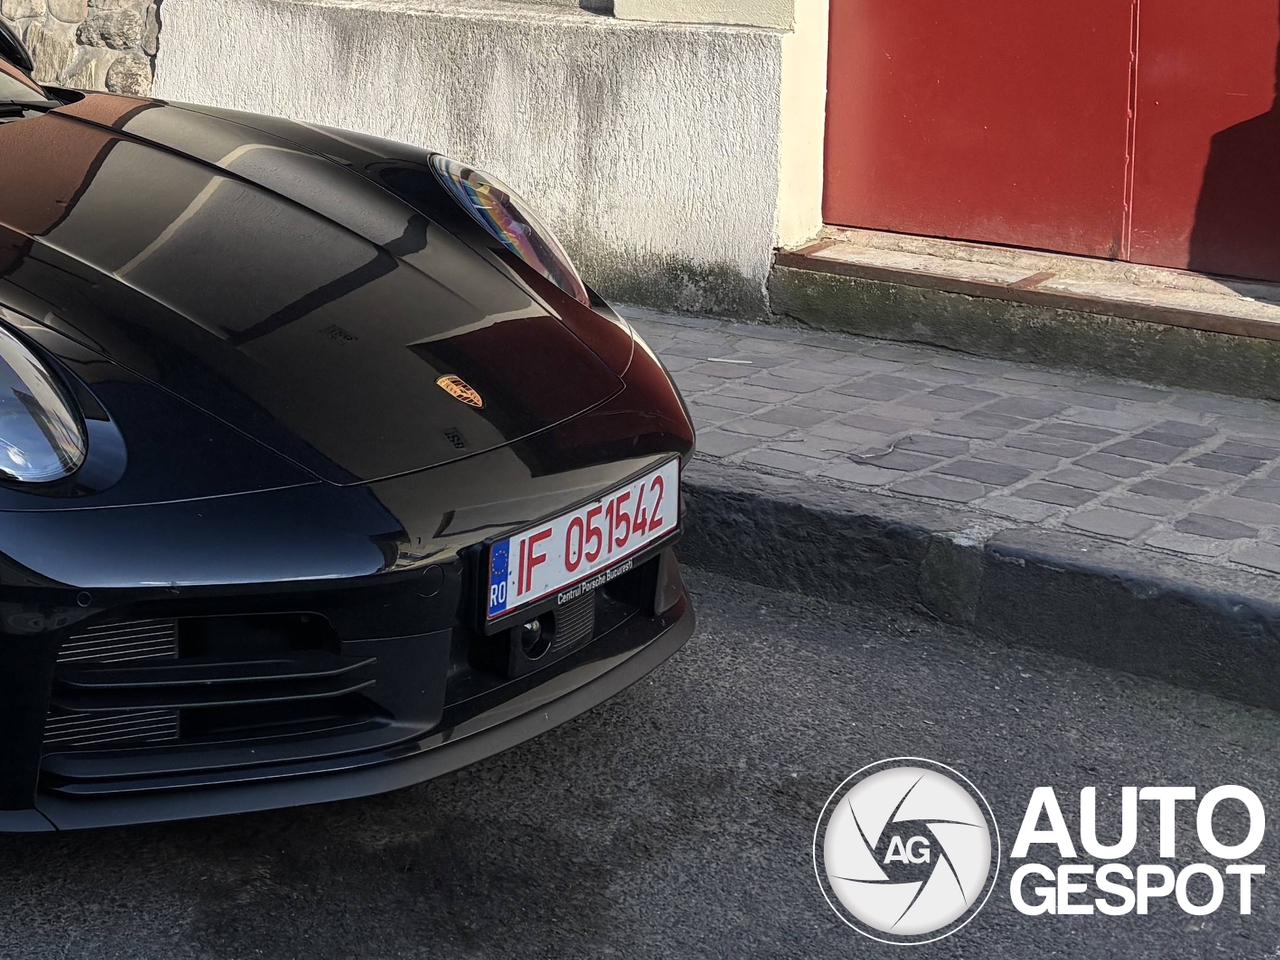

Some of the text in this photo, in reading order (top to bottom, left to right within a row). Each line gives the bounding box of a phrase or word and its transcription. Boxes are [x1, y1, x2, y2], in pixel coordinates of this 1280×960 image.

[517, 475, 664, 597] IF 051542
[490, 581, 506, 608] RO
[557, 583, 581, 605] Centrul
[582, 574, 606, 594] Porsche
